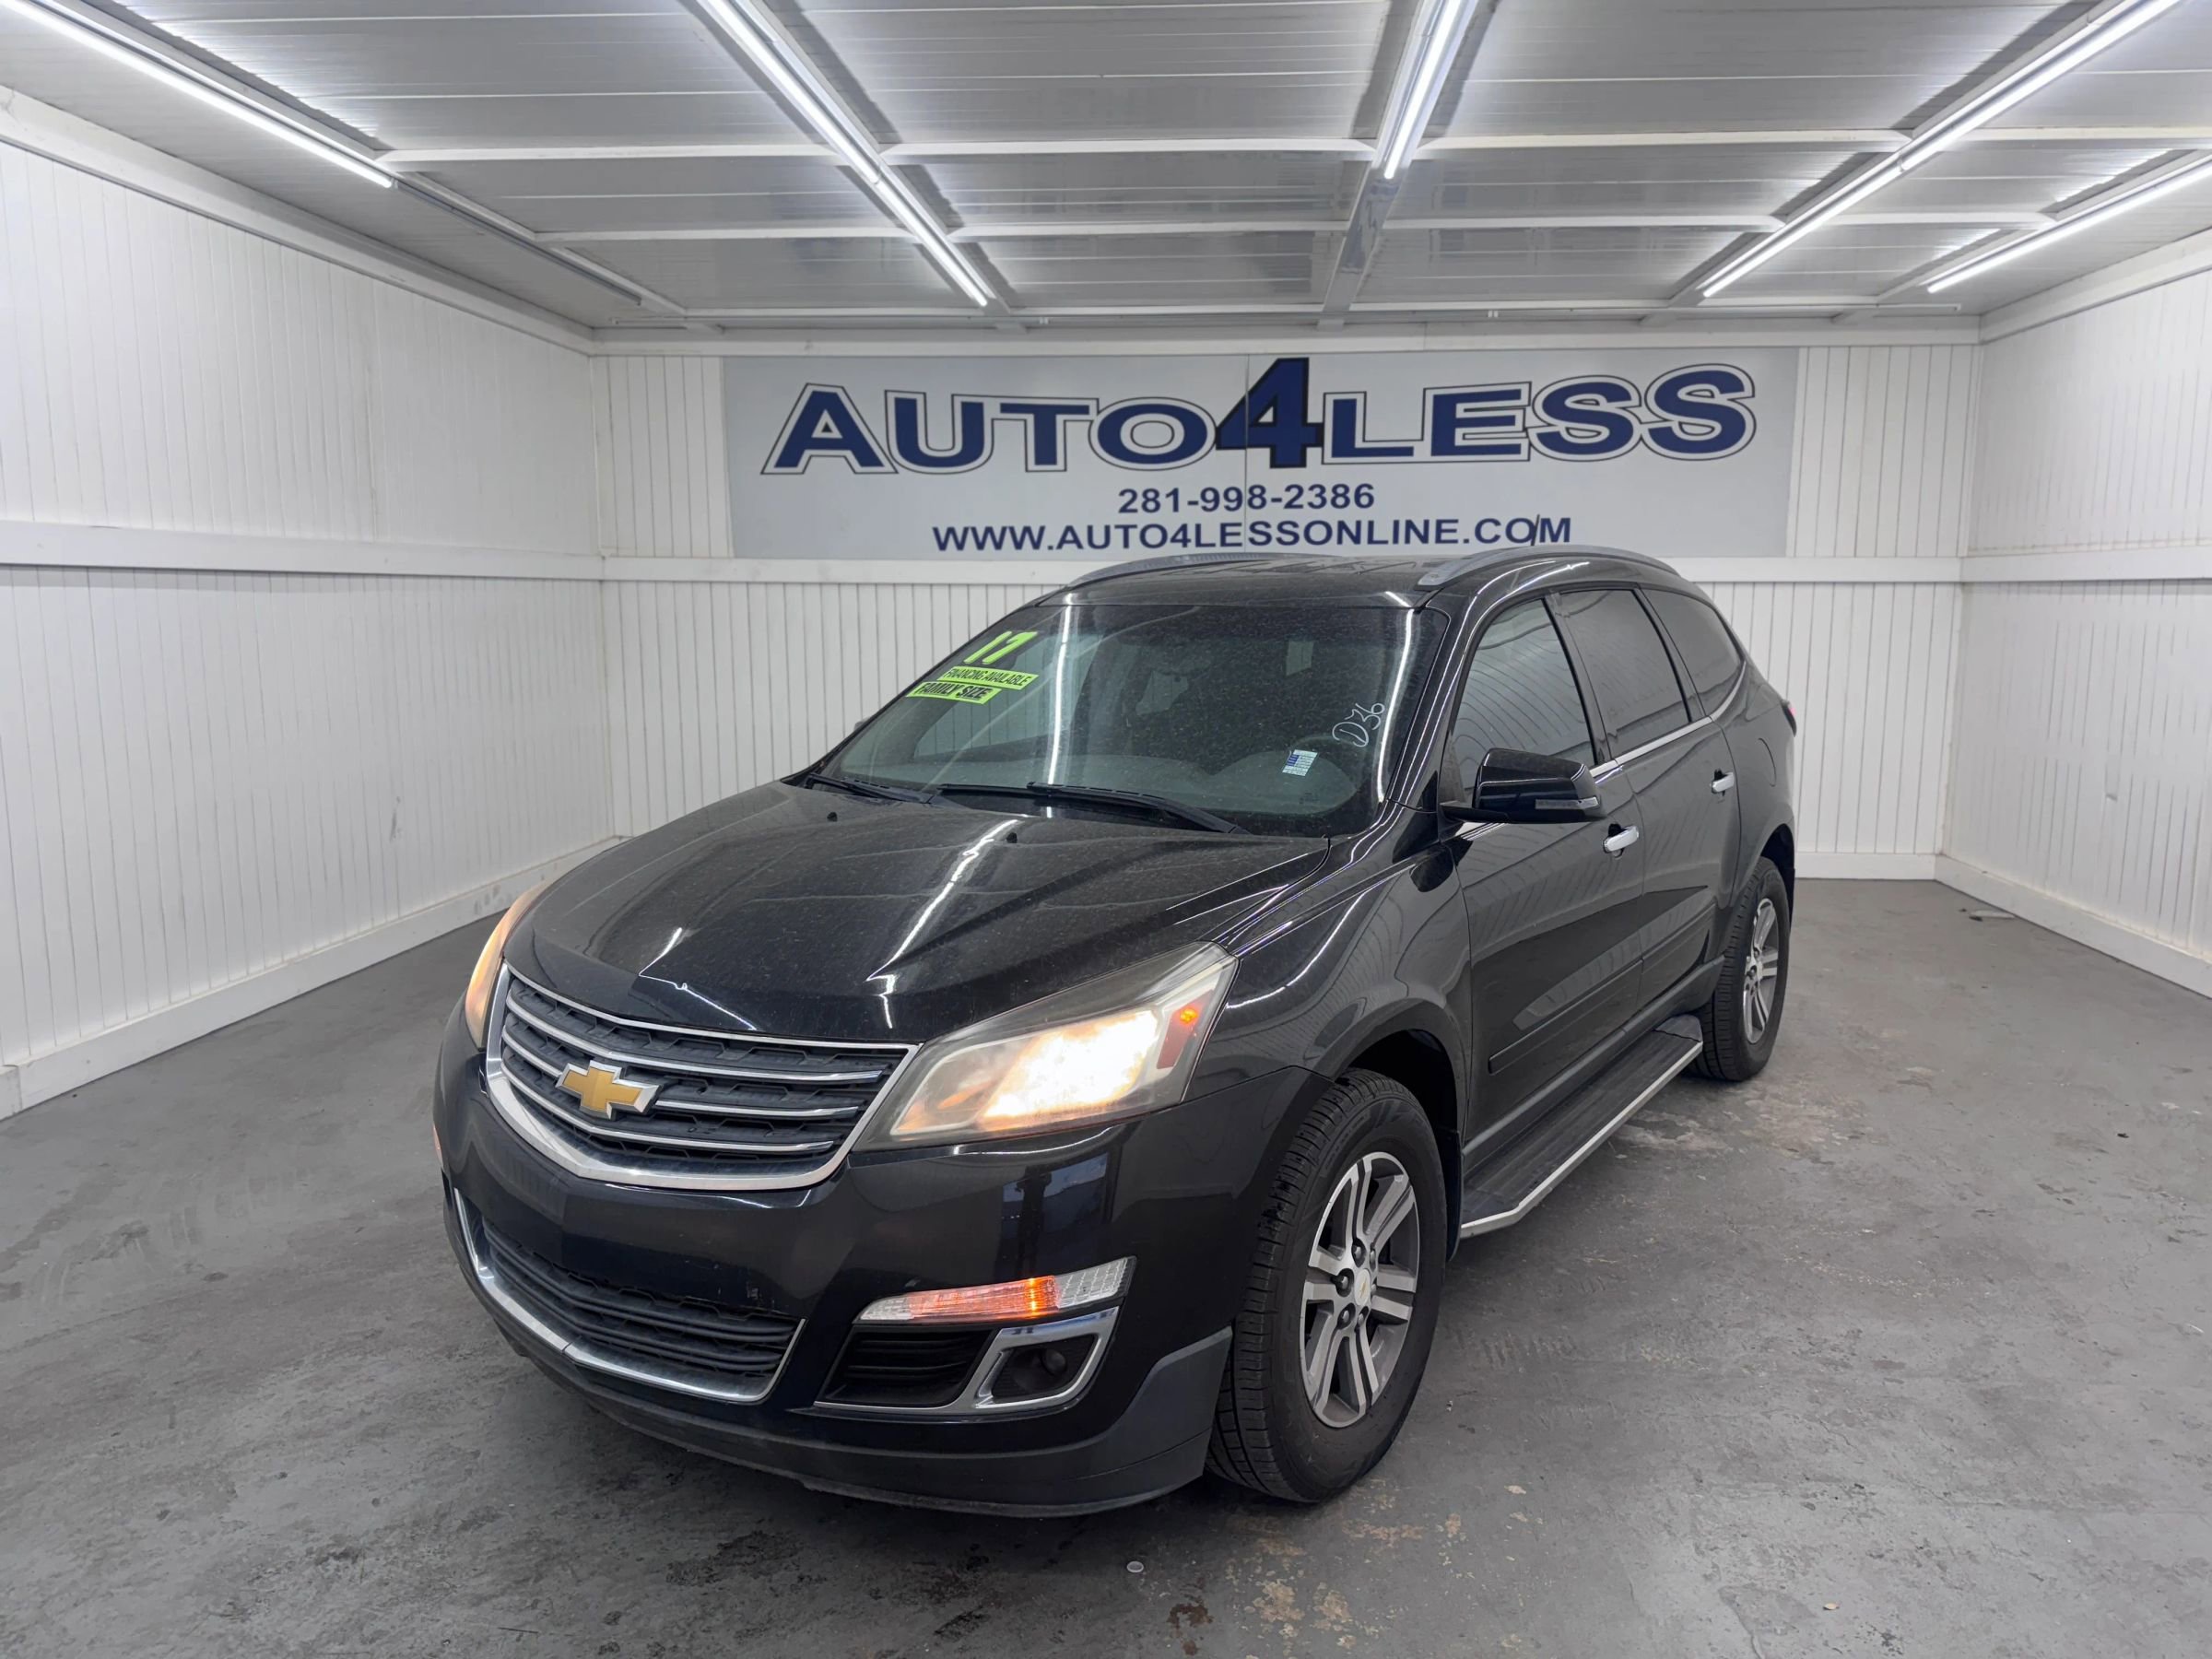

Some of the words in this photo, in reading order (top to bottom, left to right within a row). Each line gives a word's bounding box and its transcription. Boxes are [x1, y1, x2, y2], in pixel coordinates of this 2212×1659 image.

[760, 358, 1757, 476] AUTO4LESS
[1118, 484, 1375, 513] 281-998-2386
[933, 517, 1571, 550] WWW.AUTO4LESSONLINE.COM
[964, 631, 1038, 665] 17
[914, 682, 961, 696] FAMILY
[956, 686, 993, 700] SIZE
[983, 671, 1032, 686] AVAILABLE
